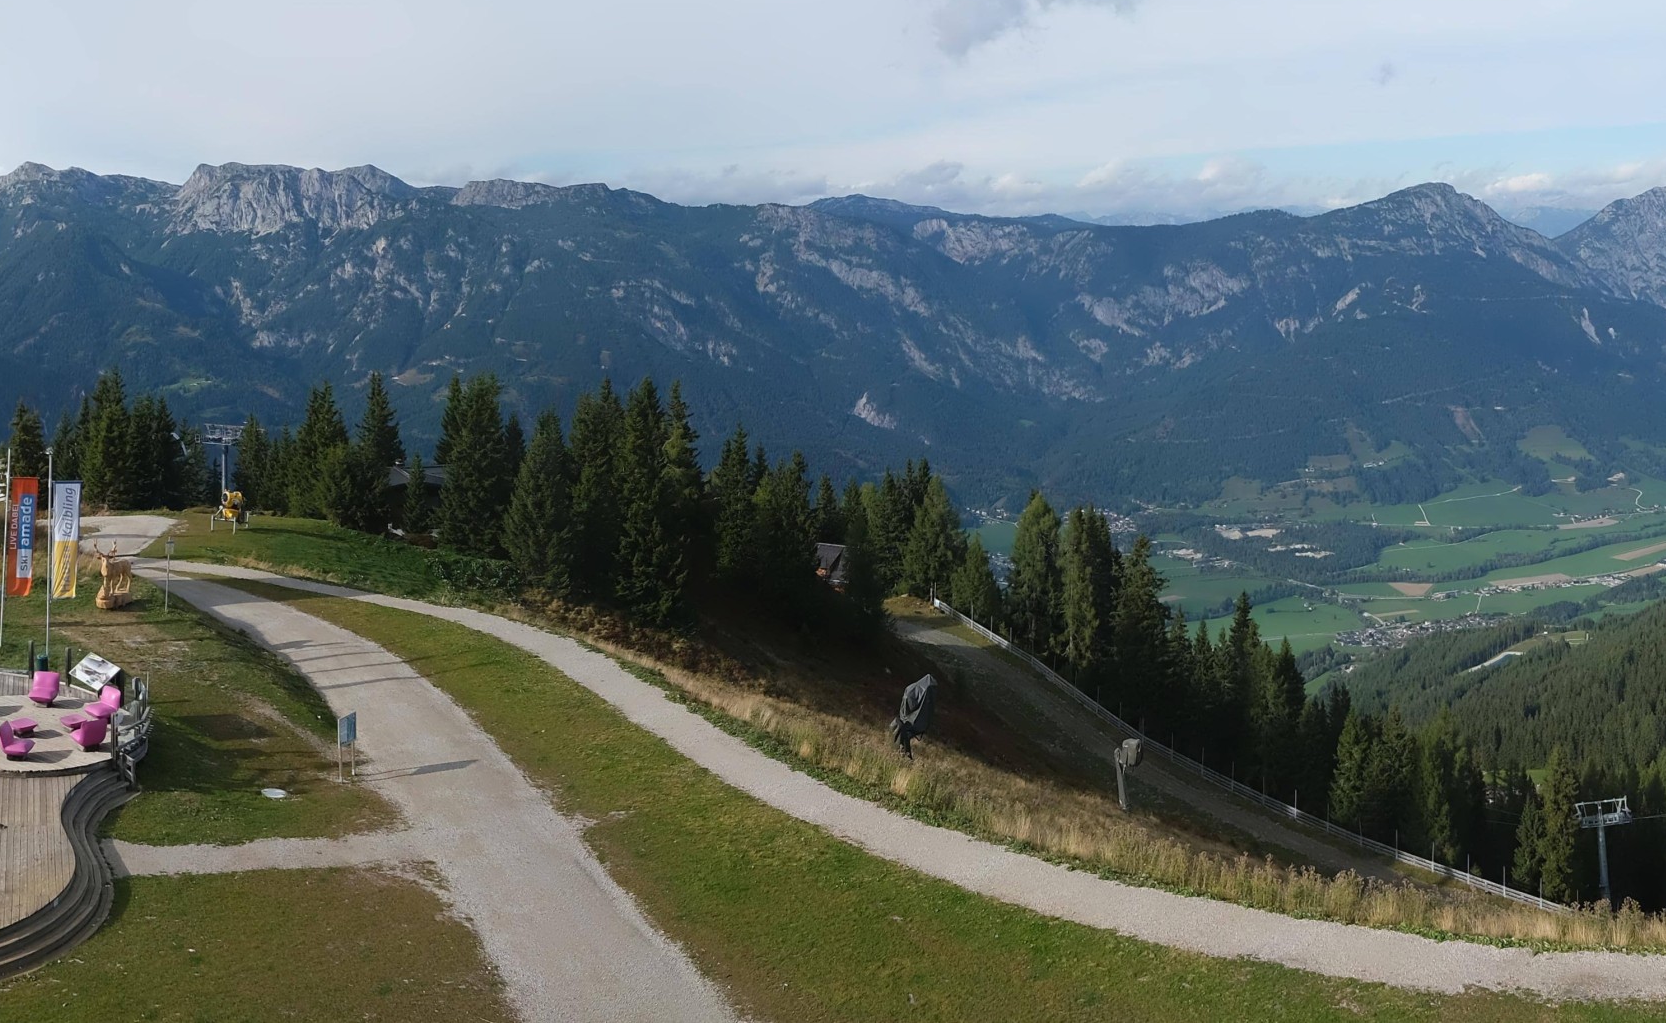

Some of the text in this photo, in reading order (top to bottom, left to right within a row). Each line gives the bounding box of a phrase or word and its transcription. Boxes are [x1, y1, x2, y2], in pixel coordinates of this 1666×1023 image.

[20, 496, 33, 547] amade
[62, 487, 76, 538] Kaibling
[9, 530, 18, 550] LIVE
